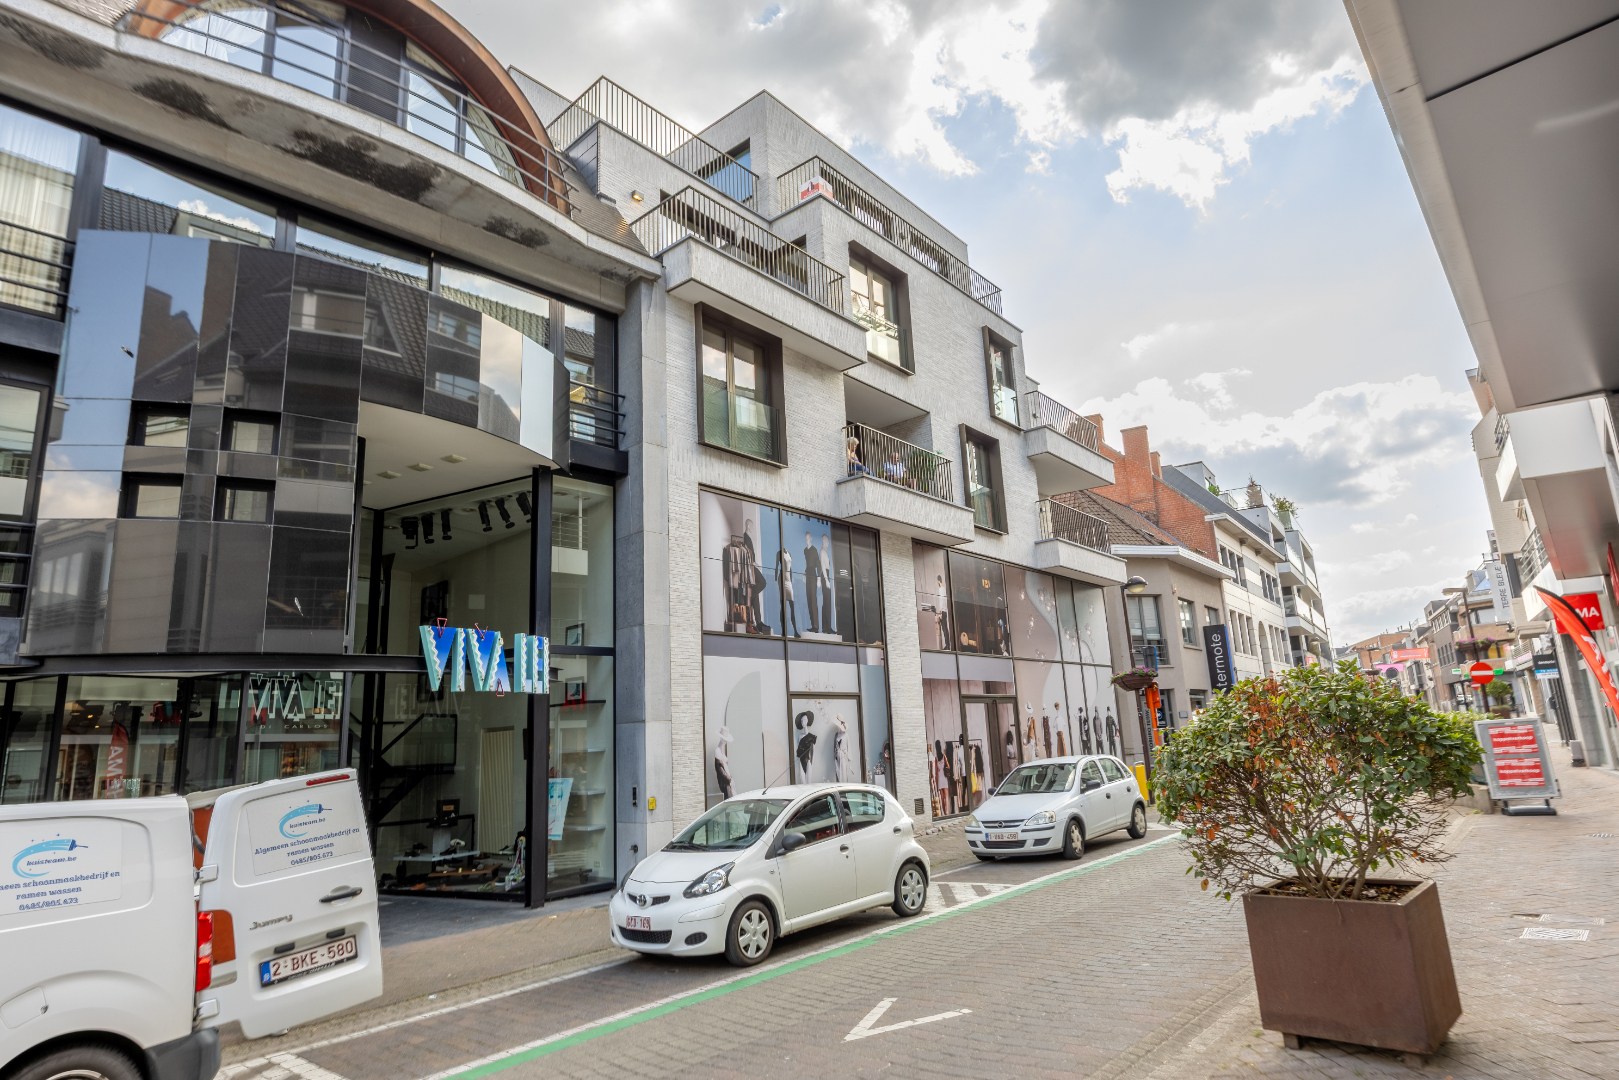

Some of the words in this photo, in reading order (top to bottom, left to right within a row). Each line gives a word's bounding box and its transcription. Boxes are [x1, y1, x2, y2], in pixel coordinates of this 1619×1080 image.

[419, 624, 511, 692] VIVA
[250, 674, 306, 721] VIVA
[254, 843, 289, 855] Algemeen
[290, 829, 351, 847] schoonmaakbedrijf
[287, 847, 310, 857] ramen
[310, 842, 335, 852] wassen
[22, 870, 109, 888] schoonmaakbedrijf
[16, 892, 47, 900] ramen
[48, 886, 82, 896] wassen
[272, 940, 354, 977] 2-BKE-580
